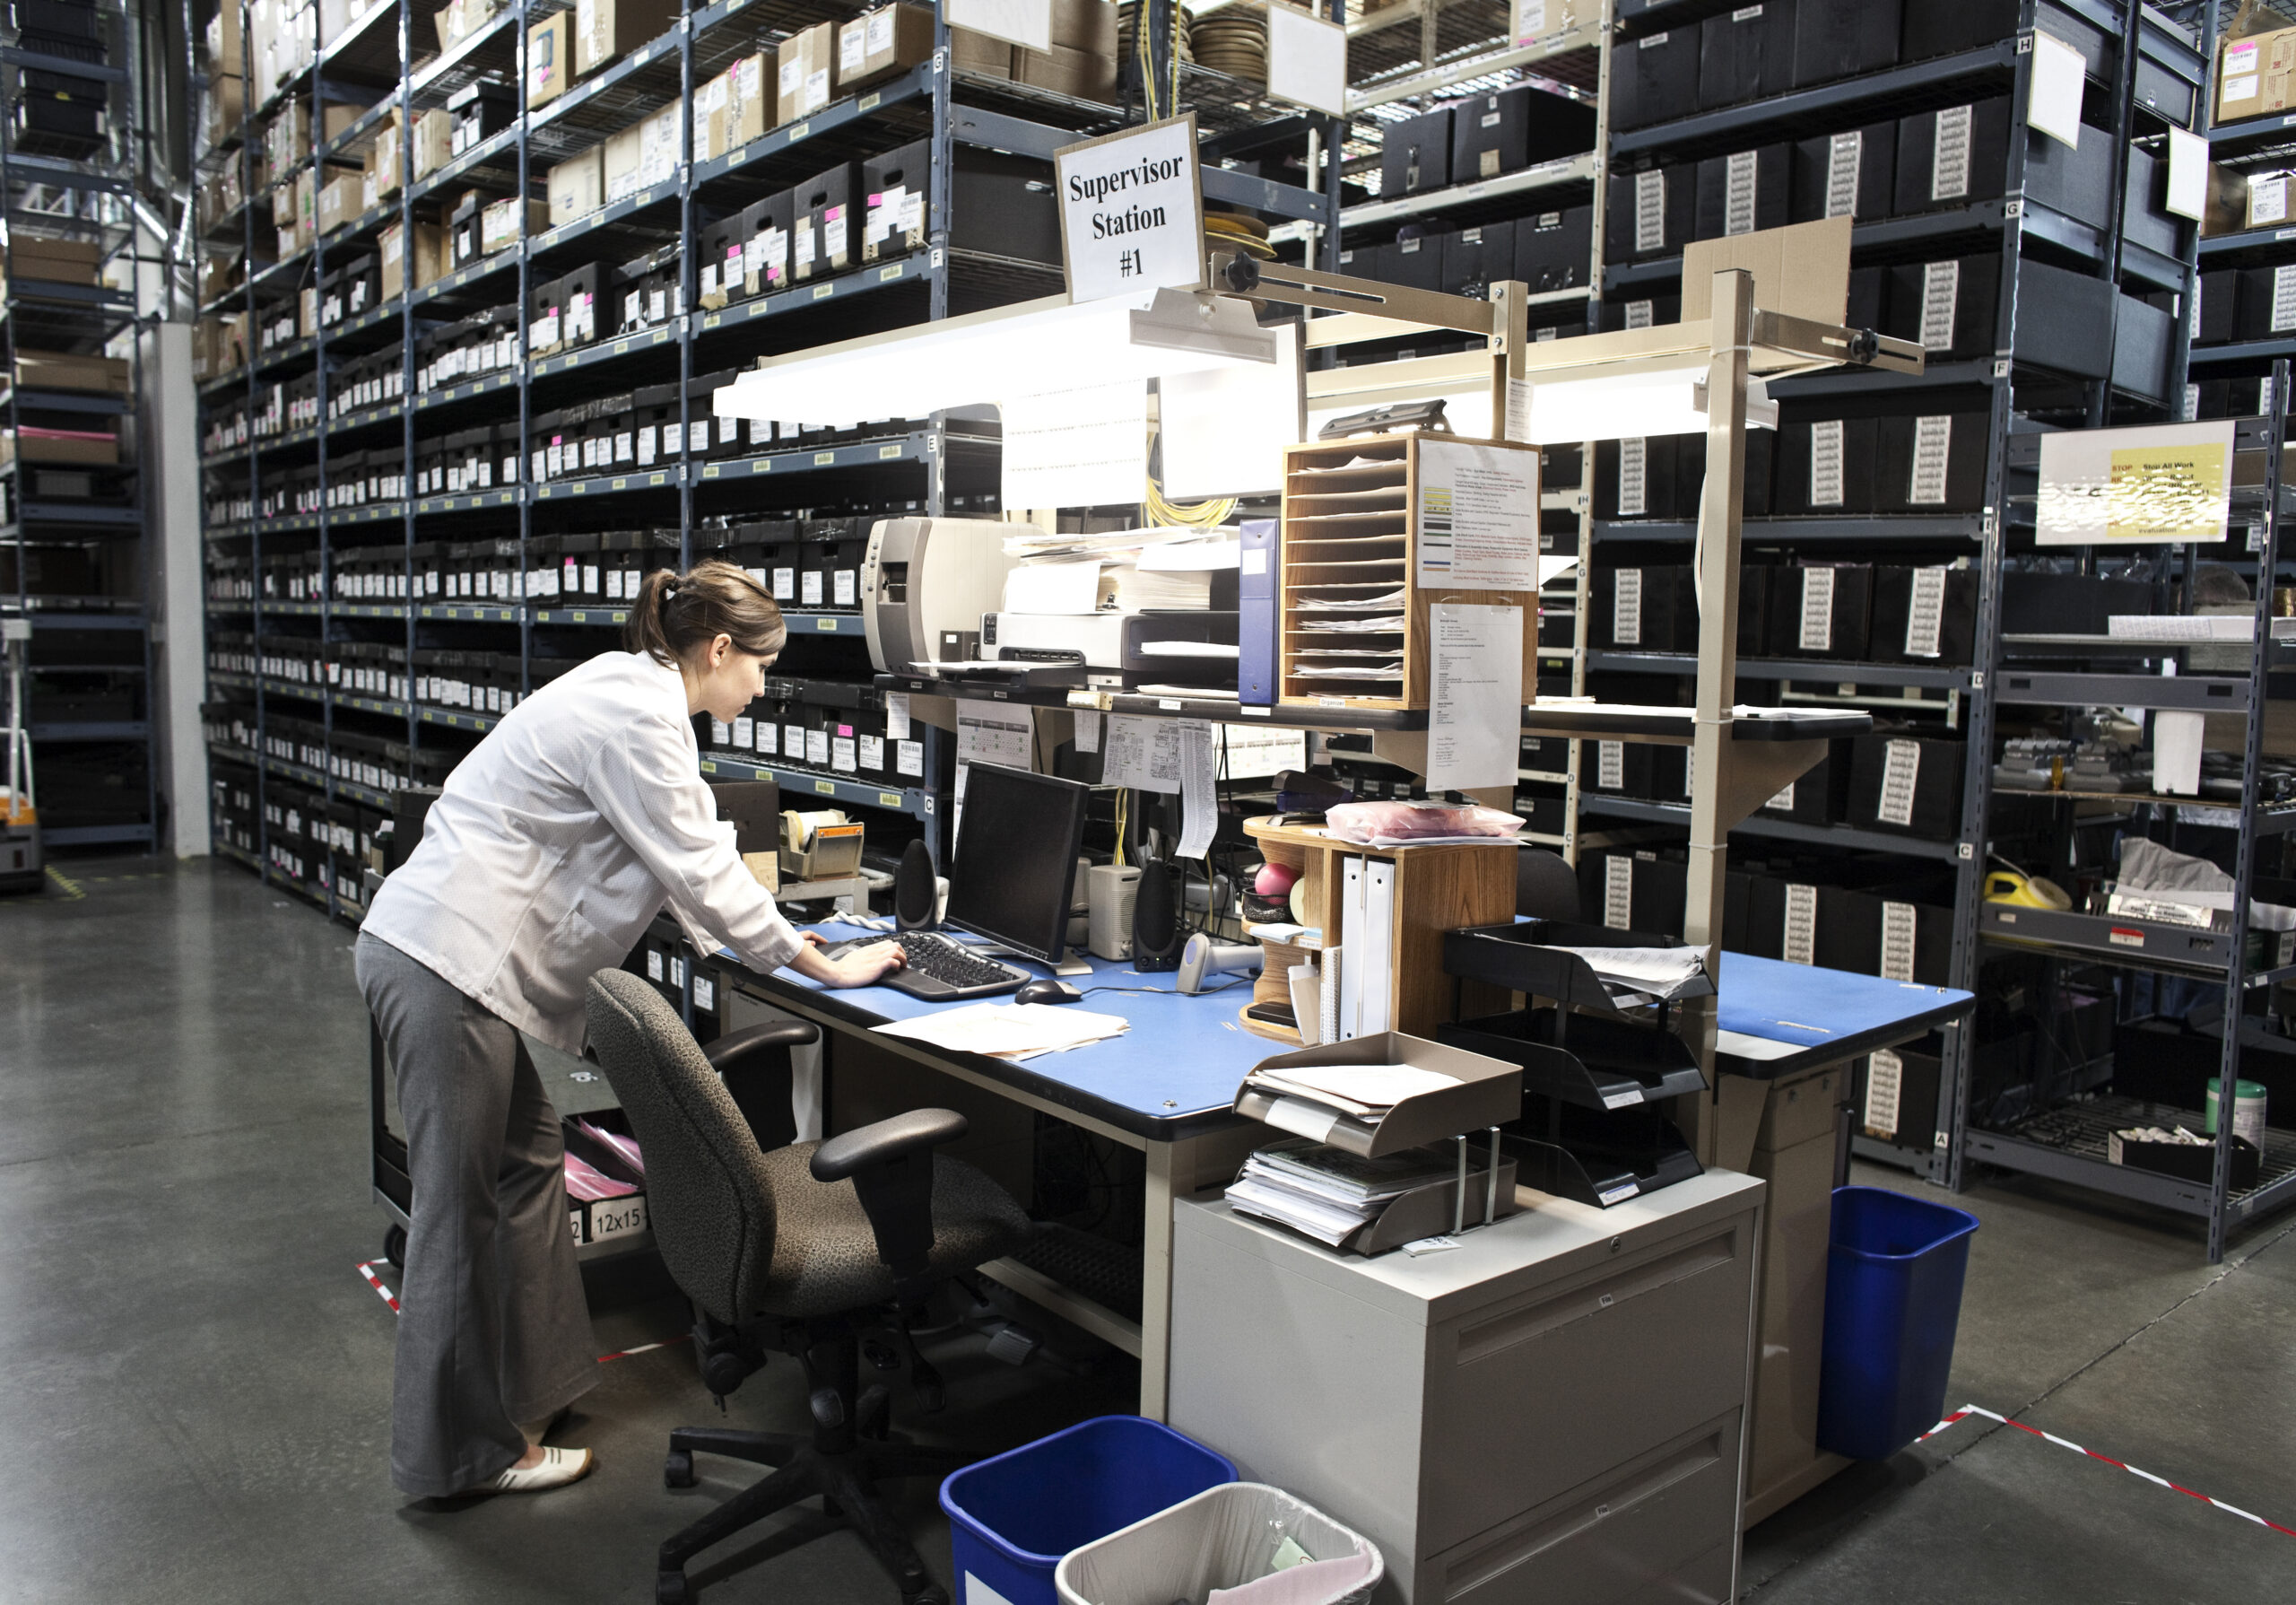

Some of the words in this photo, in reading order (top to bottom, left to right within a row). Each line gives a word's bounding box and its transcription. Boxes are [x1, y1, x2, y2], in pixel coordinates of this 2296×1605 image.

[2020, 39, 2031, 50] H
[935, 57, 942, 69] G
[1069, 156, 1184, 204] Supervisor
[2007, 203, 2018, 214] G
[1091, 204, 1167, 240] Station
[933, 252, 939, 266] F
[1119, 248, 1144, 278] #1
[1997, 362, 2005, 373] F
[929, 439, 935, 449] E
[2111, 464, 2133, 473] STOP
[1582, 495, 1589, 503] H
[1578, 569, 1586, 578] G
[1975, 675, 1984, 685] D
[1568, 773, 1574, 782] D
[926, 798, 932, 811] C
[1565, 833, 1571, 842] C
[1961, 845, 1970, 856] C
[1936, 1133, 1946, 1145] A
[596, 1208, 640, 1234] 12x15
